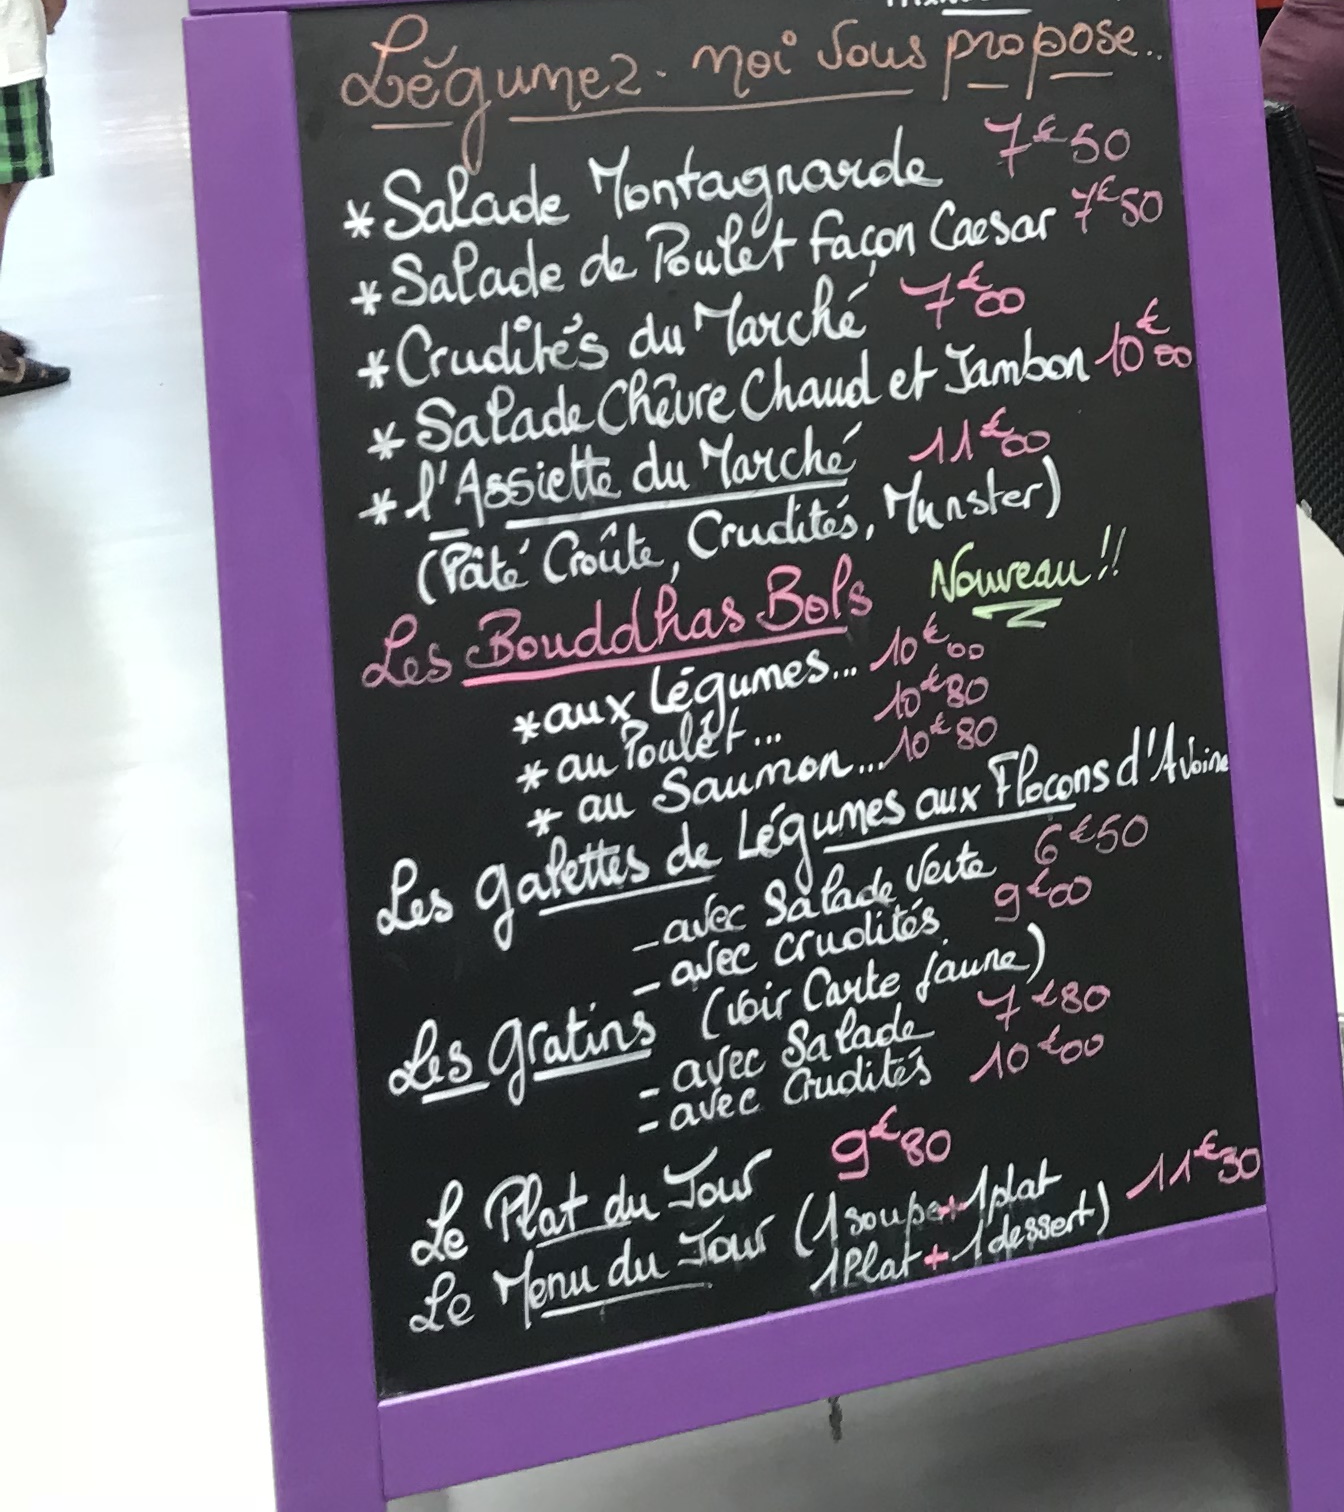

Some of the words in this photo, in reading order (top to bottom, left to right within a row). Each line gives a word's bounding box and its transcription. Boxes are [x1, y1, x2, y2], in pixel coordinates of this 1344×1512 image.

[383, 164, 570, 241] Salade
[588, 125, 944, 239] Montagnarde
[392, 238, 566, 307] Salade
[579, 234, 638, 288] de
[645, 212, 798, 283] Poulet
[929, 199, 1058, 252] Caesar
[396, 312, 610, 388] Crudités
[629, 312, 687, 360] du
[694, 274, 869, 356] Marché
[415, 384, 596, 454] Salade
[741, 348, 882, 422] Chaud
[889, 345, 938, 402] et
[945, 327, 1091, 395] Jambon
[632, 439, 690, 495] du
[699, 421, 863, 490] Marché
[361, 612, 453, 688] Les
[464, 583, 747, 669] Bouddhas
[755, 552, 874, 632] Bols
[376, 857, 455, 936] Les
[666, 820, 722, 877] de
[737, 788, 906, 890] Légumes
[915, 781, 981, 821] aux
[987, 743, 1110, 807] Flocons
[388, 1017, 474, 1097] Les
[410, 1179, 468, 1266] Le
[484, 1172, 588, 1243] Plat
[604, 1174, 661, 1223] du
[662, 1146, 773, 1210] Jour
[408, 1270, 475, 1333] Le
[492, 1248, 599, 1329] Menu
[608, 1236, 671, 1289] du
[677, 1214, 777, 1269] Jour
